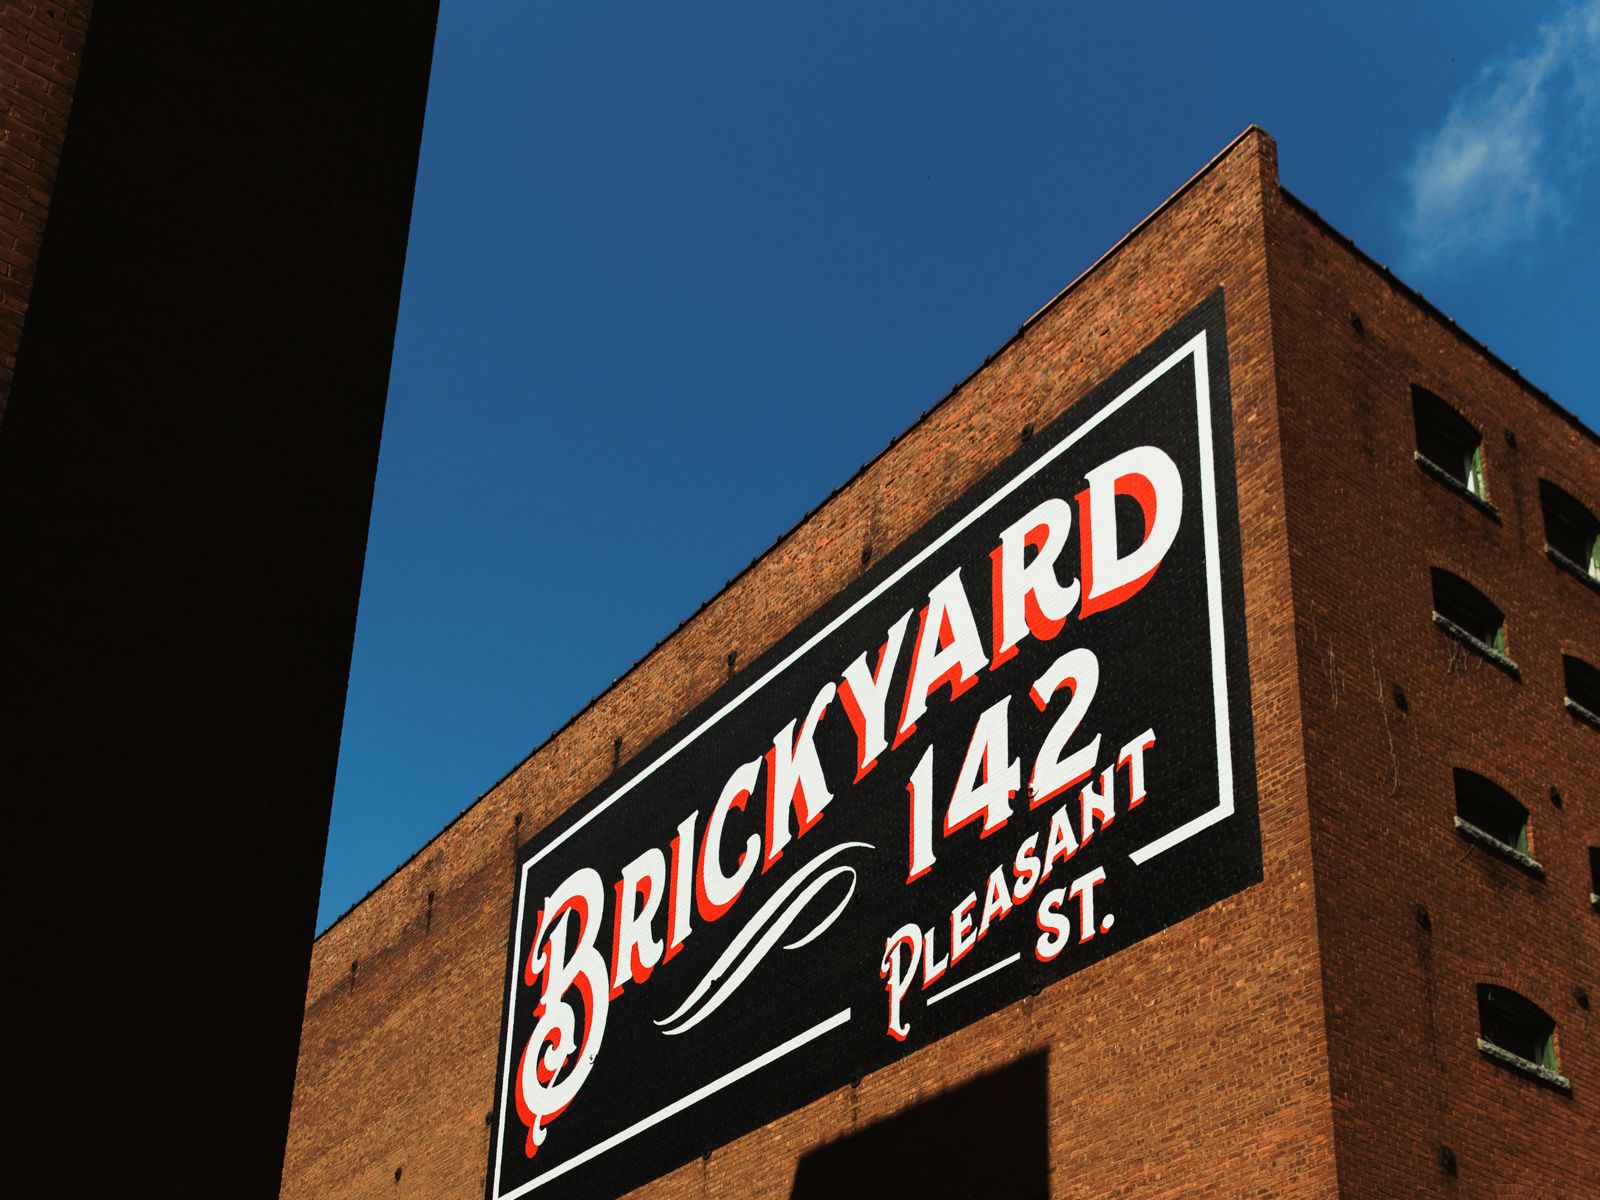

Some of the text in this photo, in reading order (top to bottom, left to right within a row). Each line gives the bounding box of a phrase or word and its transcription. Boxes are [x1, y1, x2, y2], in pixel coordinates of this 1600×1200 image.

[515, 446, 1183, 1158] BRICKYARD
[880, 728, 1156, 1041] PLEASANT
[906, 648, 1101, 884] 142
[1035, 866, 1115, 962] ST.
